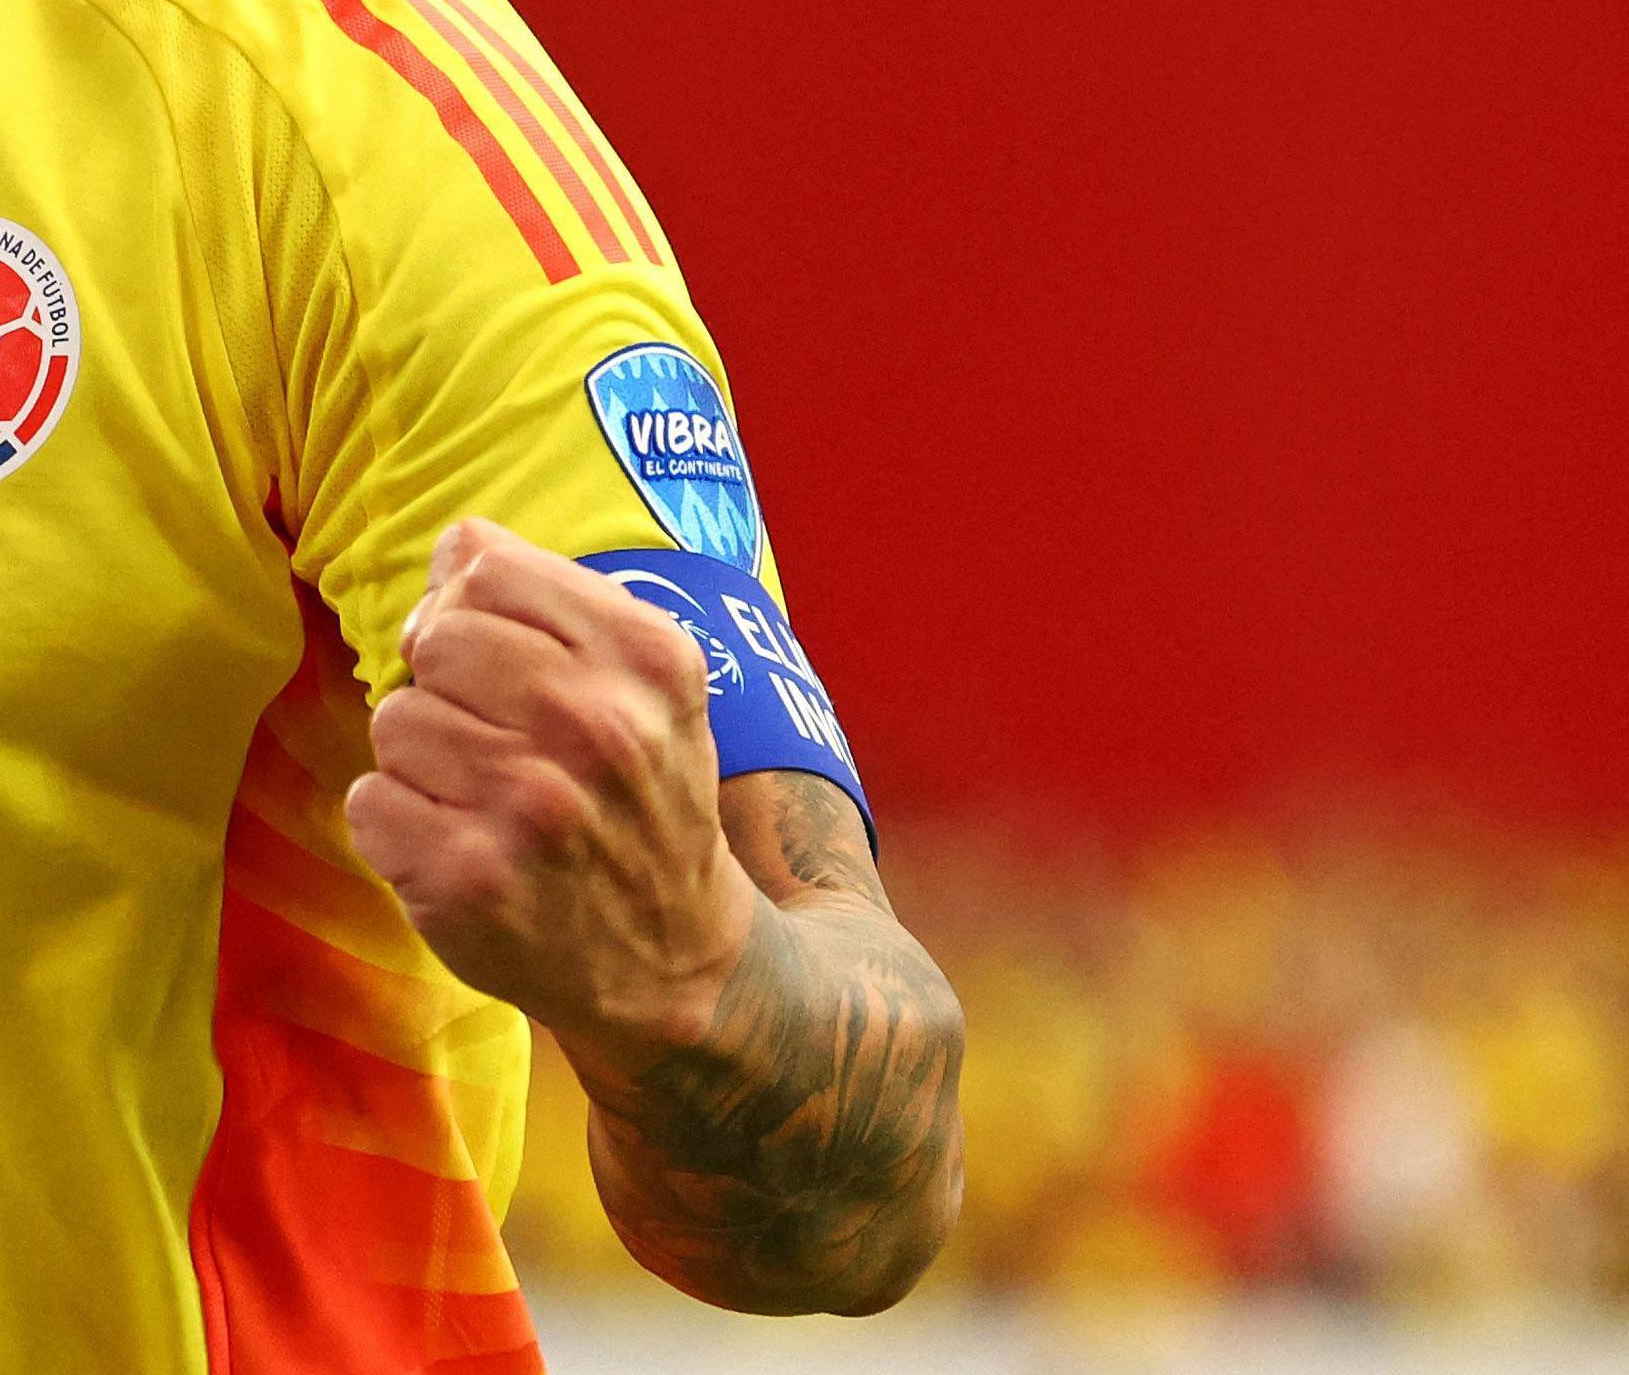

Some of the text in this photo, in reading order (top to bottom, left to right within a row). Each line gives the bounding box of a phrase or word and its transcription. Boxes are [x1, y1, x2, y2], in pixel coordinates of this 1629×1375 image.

[21, 248, 45, 276] DE
[36, 270, 70, 348] FÚTBOL
[630, 410, 737, 462] VIBRA
[645, 459, 743, 482] EL CONTINENTE
[721, 593, 835, 714] ELI
